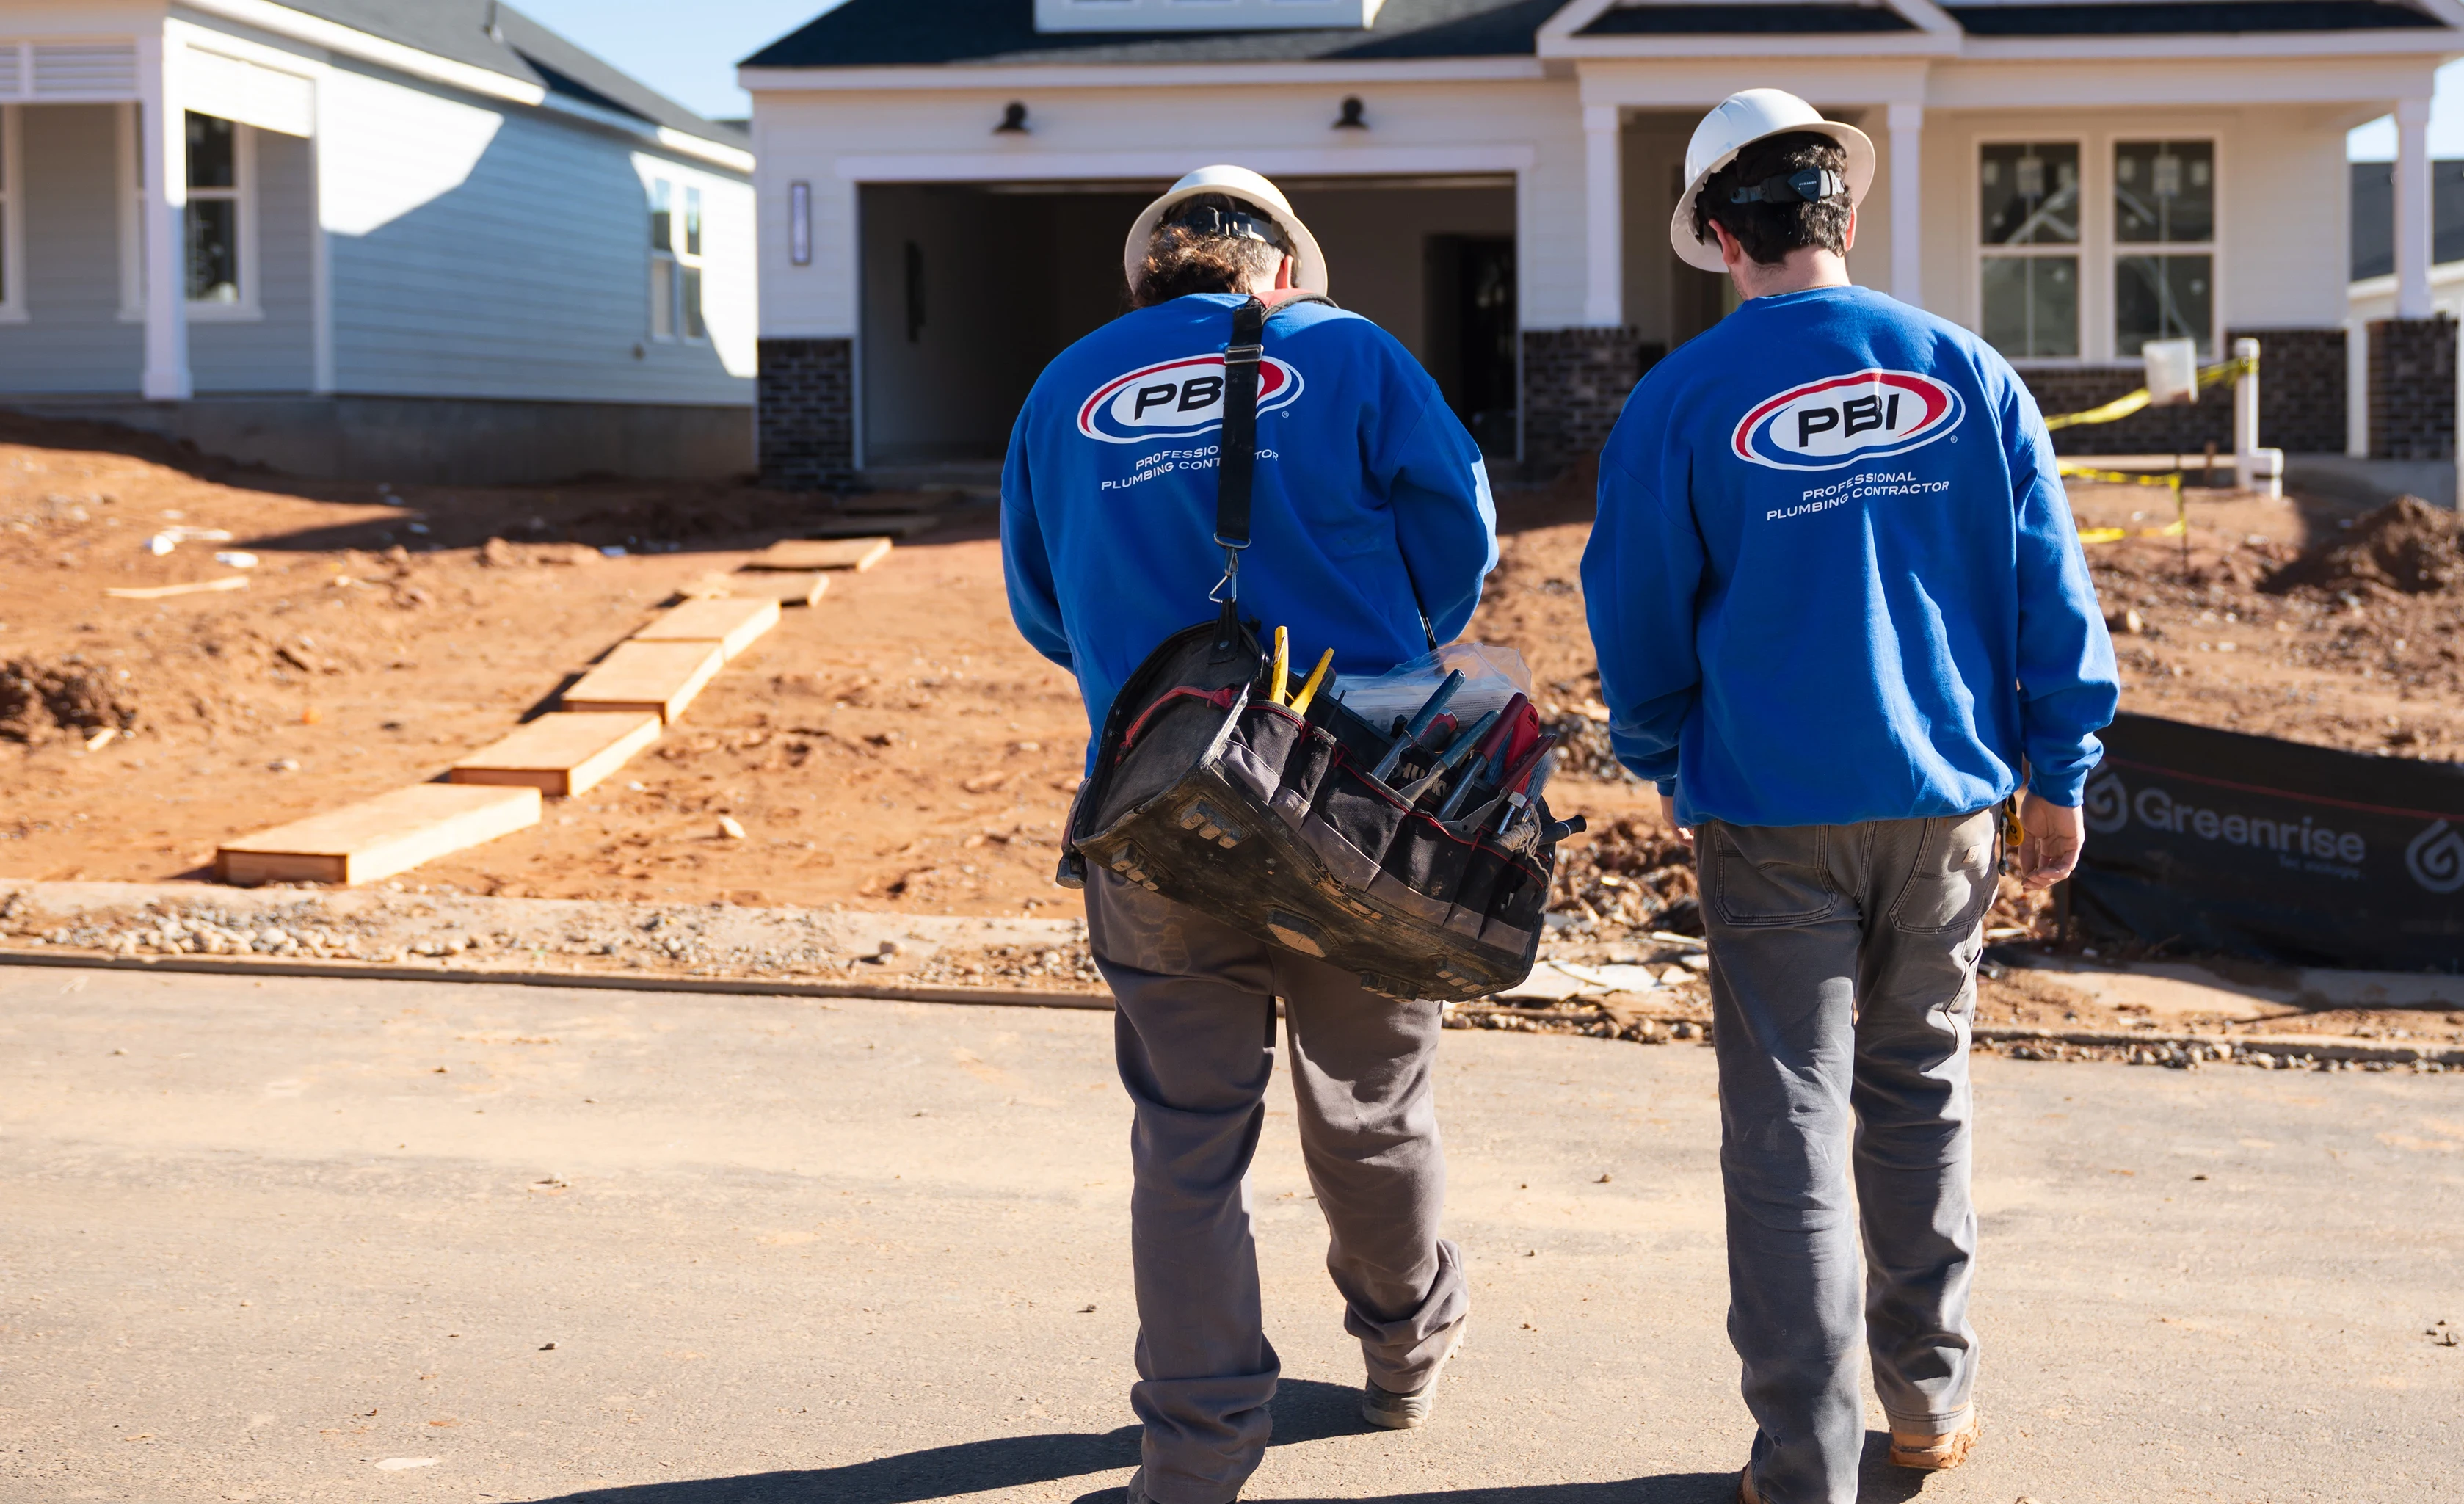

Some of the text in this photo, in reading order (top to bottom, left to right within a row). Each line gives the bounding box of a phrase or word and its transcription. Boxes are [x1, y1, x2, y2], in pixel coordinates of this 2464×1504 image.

[1135, 376, 1225, 421] PB
[1798, 393, 1900, 448] PBI
[1101, 448, 1279, 490] PLUMBING CONTTOR
[1135, 445, 1221, 471] PROFESSIO
[1767, 481, 1949, 521] PLUMBING CONTRACTOR
[1803, 471, 1916, 501] PROFESSIONAL
[2134, 788, 2366, 864] Greenrise
